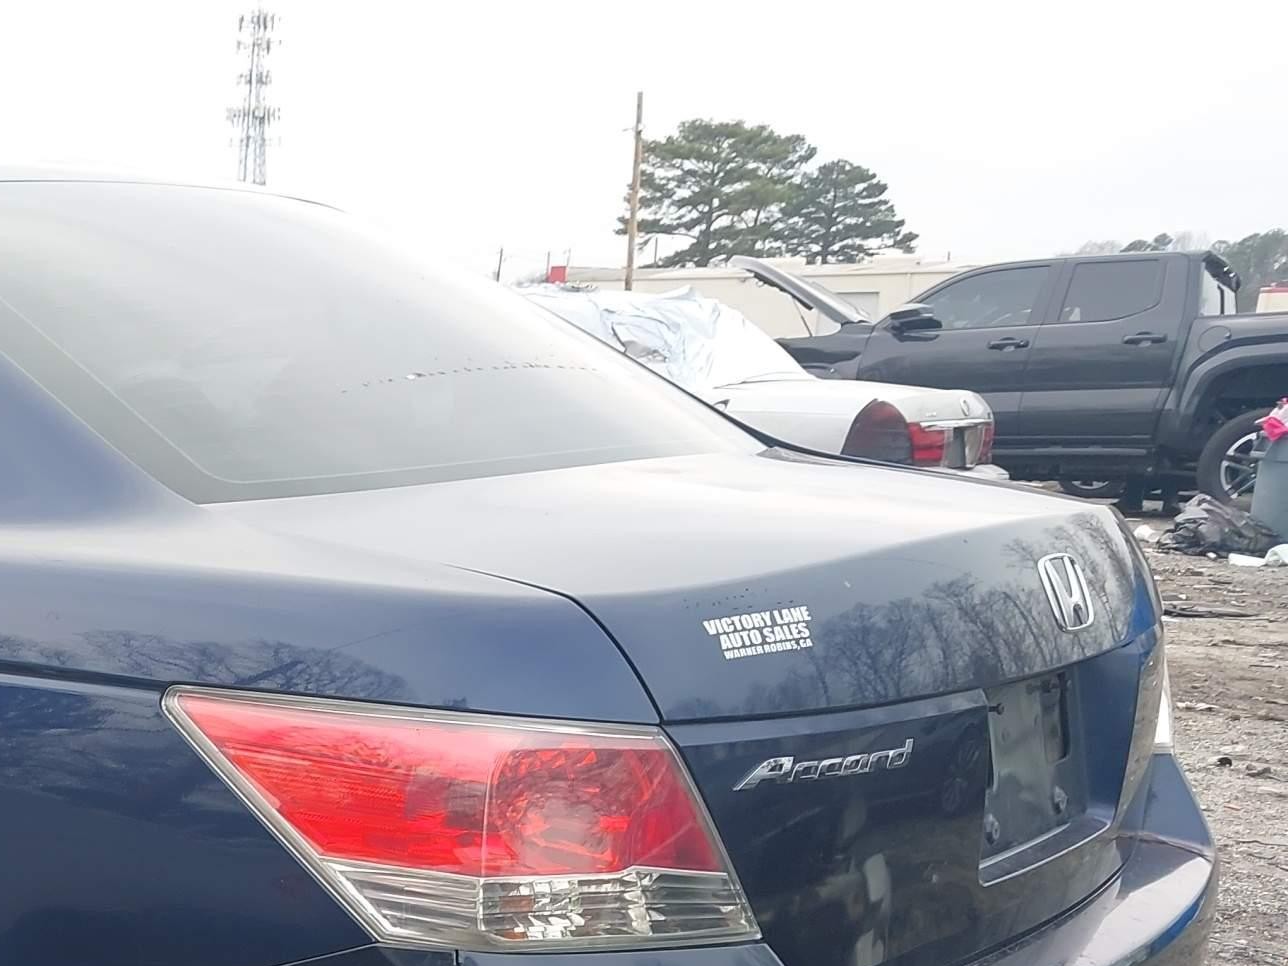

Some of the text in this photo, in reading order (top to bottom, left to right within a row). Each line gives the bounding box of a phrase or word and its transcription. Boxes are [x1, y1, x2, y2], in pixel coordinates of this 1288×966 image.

[702, 606, 812, 635] VICTORY LANE
[719, 622, 810, 650] AUTO SALES
[723, 645, 764, 660] WARNER
[732, 738, 914, 792] Accord
